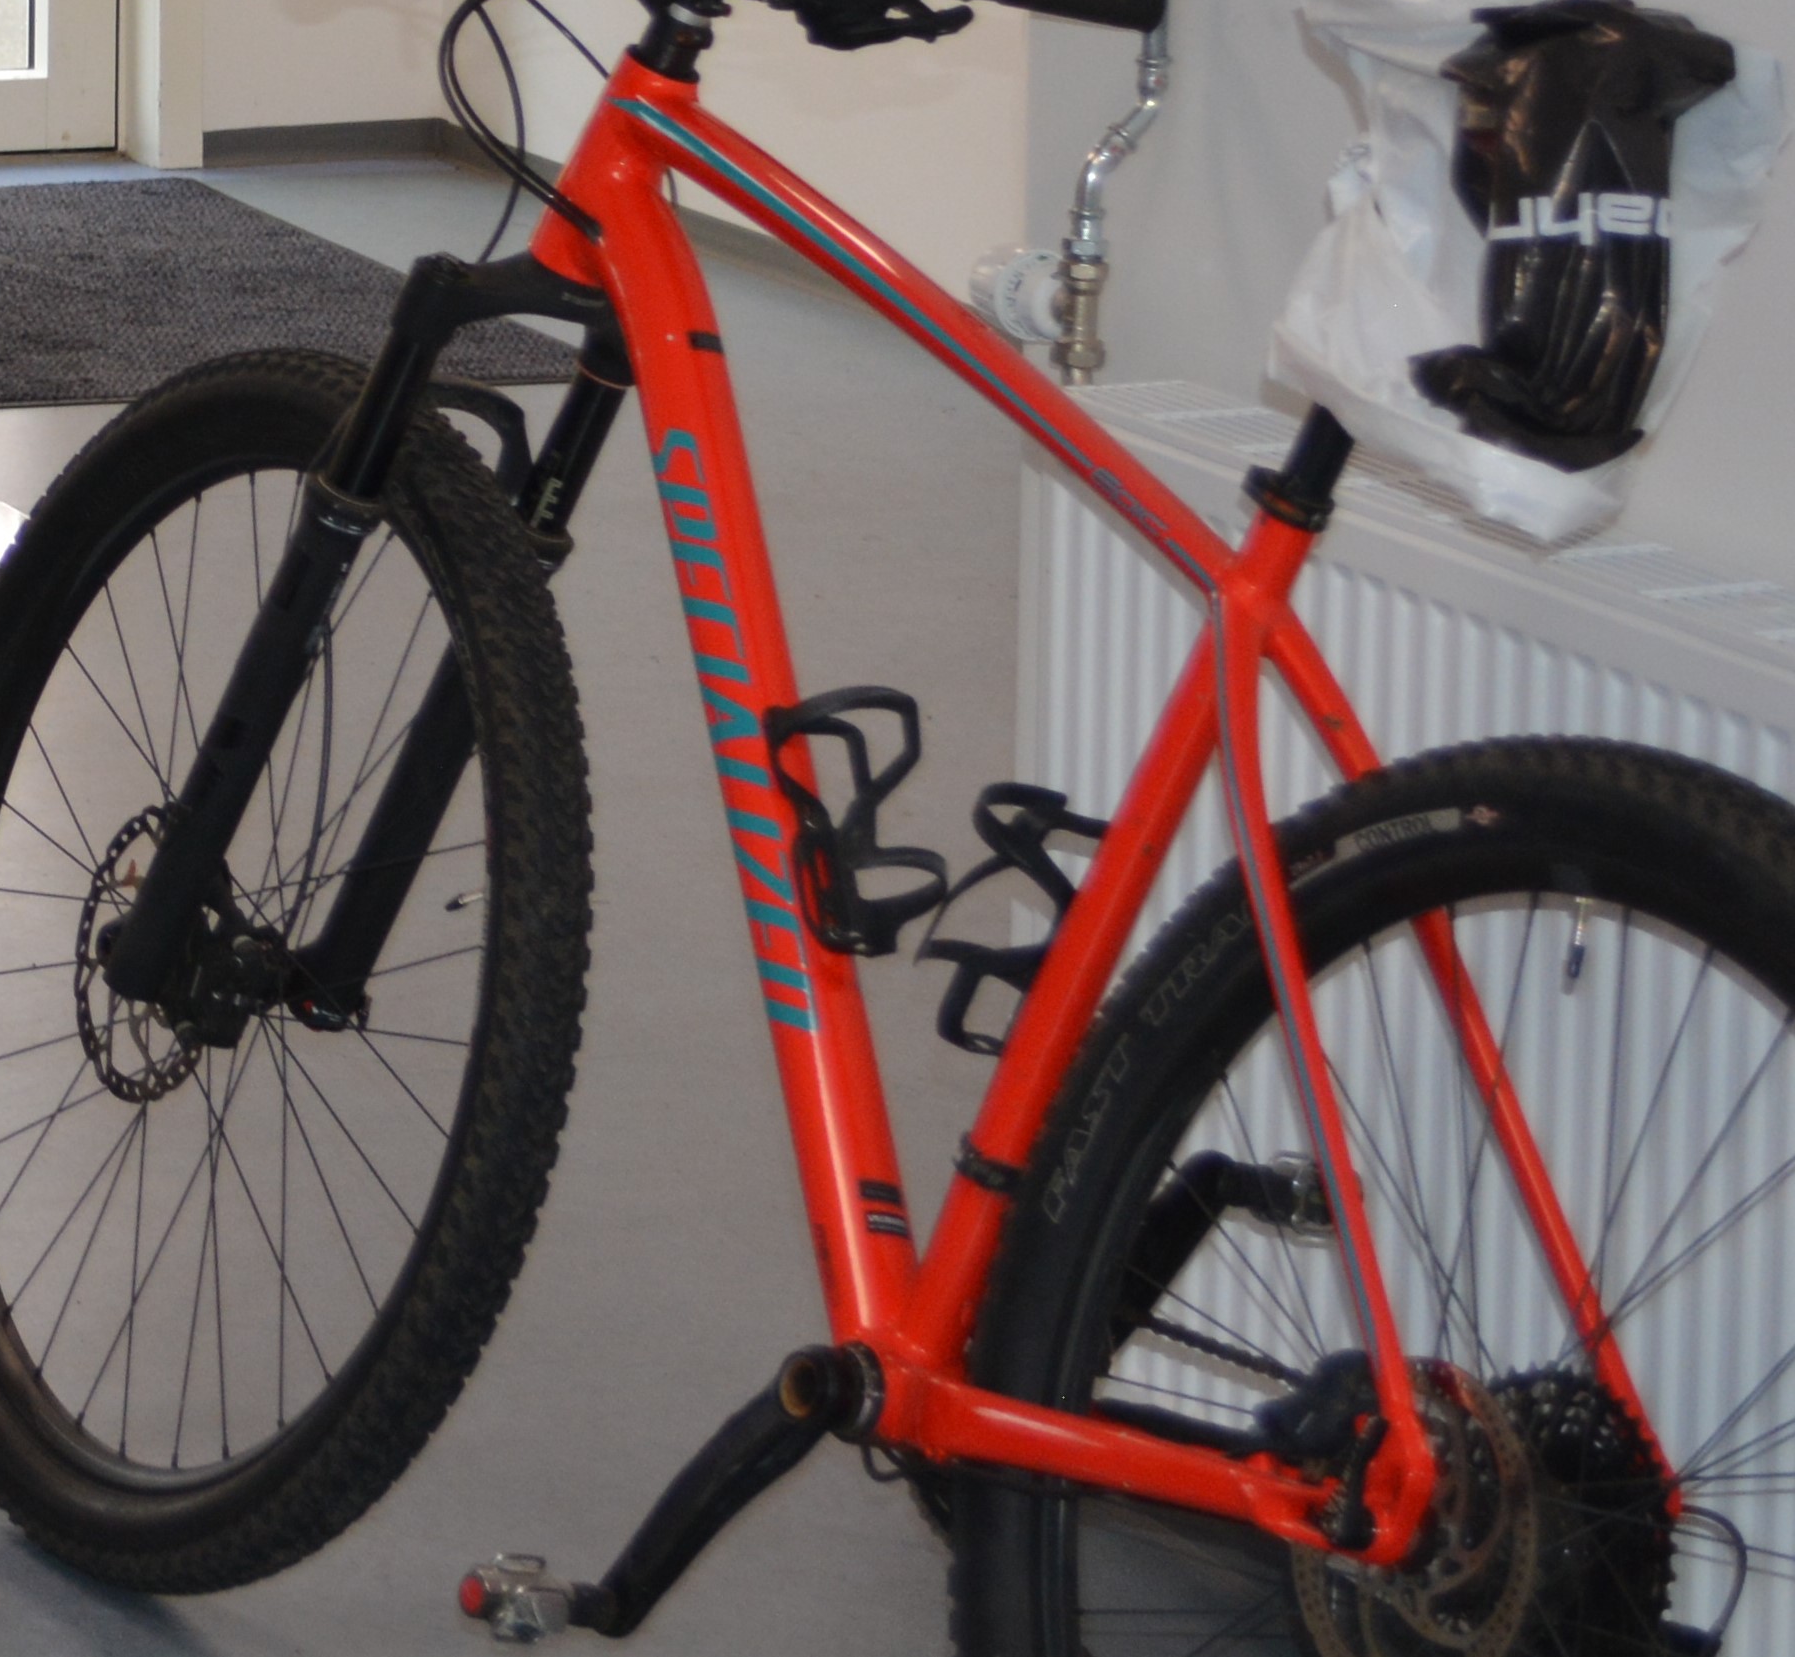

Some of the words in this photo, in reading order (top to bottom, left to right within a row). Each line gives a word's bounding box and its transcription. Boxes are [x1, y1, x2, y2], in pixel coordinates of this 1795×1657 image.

[650, 427, 821, 1034] SPECIALIZED
[1354, 813, 1433, 852] CONTROL
[1139, 897, 1256, 1028] TRA
